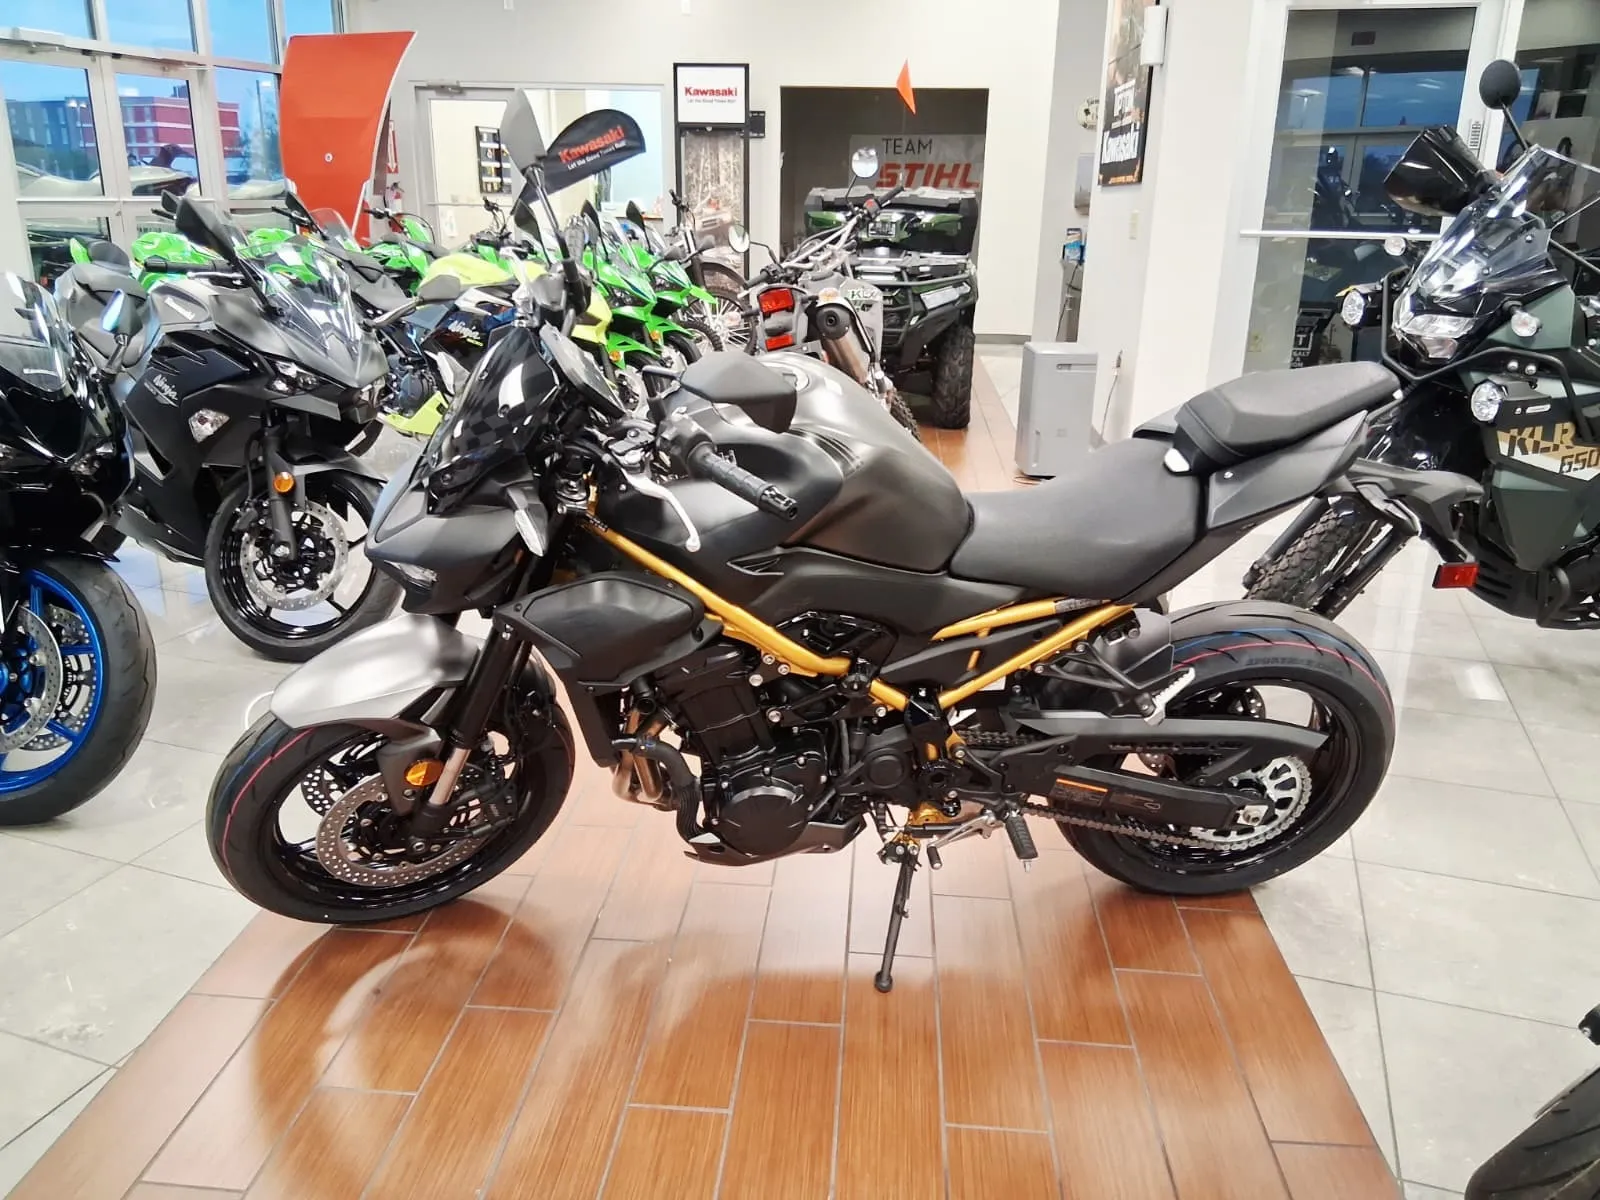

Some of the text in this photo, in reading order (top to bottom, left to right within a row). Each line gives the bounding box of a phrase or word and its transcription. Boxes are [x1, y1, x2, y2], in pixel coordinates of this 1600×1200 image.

[684, 86, 738, 97] Kawasaki
[558, 125, 625, 164] Kawasaki
[882, 137, 933, 155] TEAM
[875, 162, 980, 189] STIHL
[1507, 421, 1576, 456] KLR
[1560, 448, 1600, 474] 650
